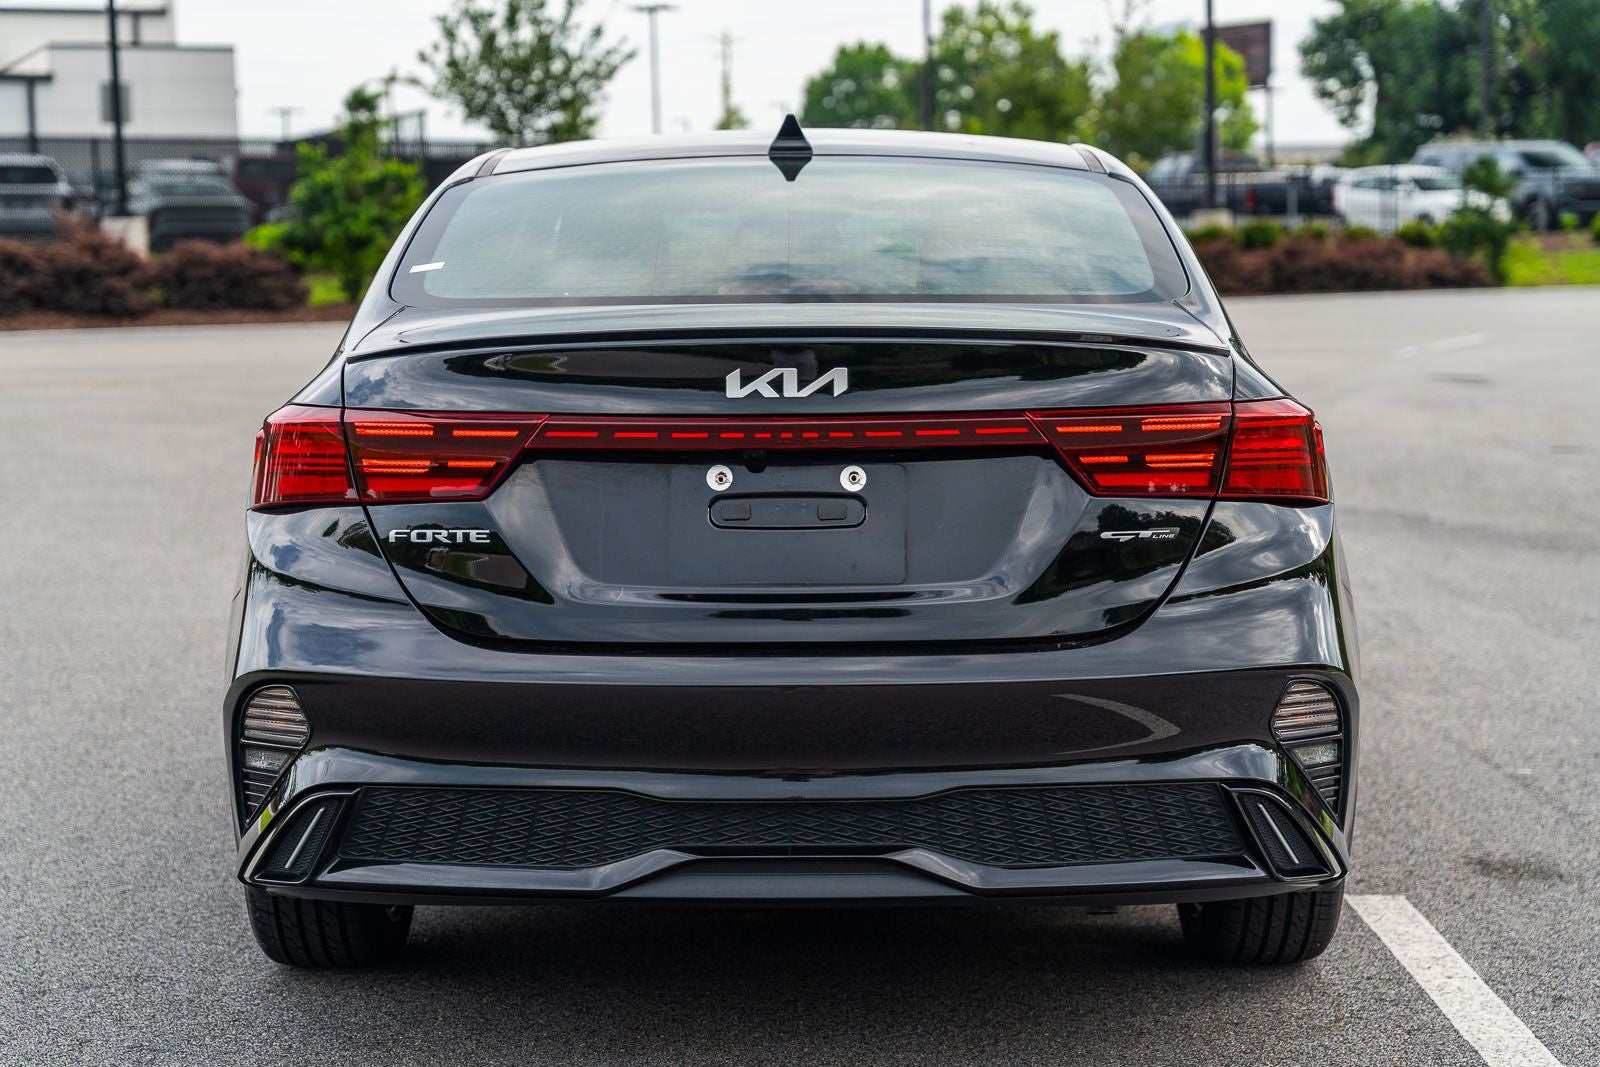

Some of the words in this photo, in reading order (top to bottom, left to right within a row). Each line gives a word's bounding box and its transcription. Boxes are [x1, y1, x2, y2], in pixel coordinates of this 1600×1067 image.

[726, 367, 848, 398] KIA
[388, 529, 491, 543] FORTE
[1100, 530, 1170, 542] GT
